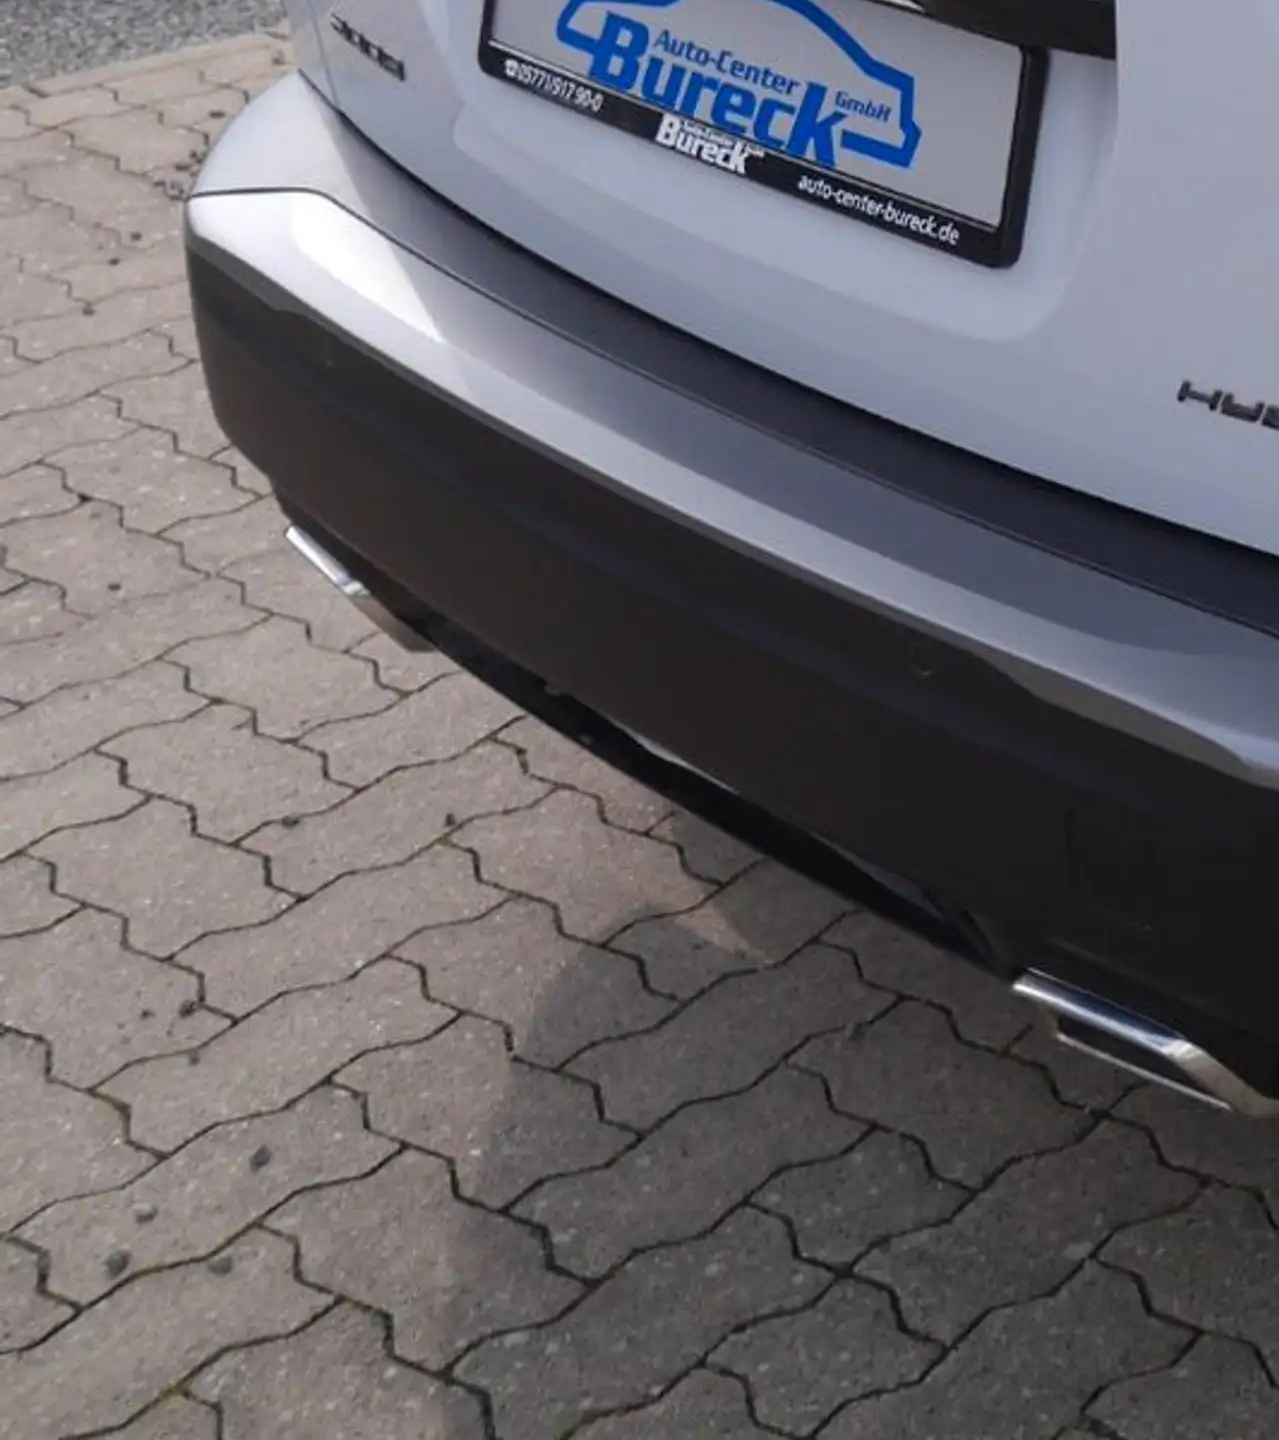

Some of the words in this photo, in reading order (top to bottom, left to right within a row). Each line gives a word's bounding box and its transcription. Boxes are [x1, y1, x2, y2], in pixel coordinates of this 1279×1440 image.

[588, 10, 846, 167] Bureck
[652, 29, 802, 97] Auto-Center
[835, 90, 892, 123] GmbH
[655, 112, 746, 175] Bureck
[797, 174, 961, 246] auto-center-bureck.de
